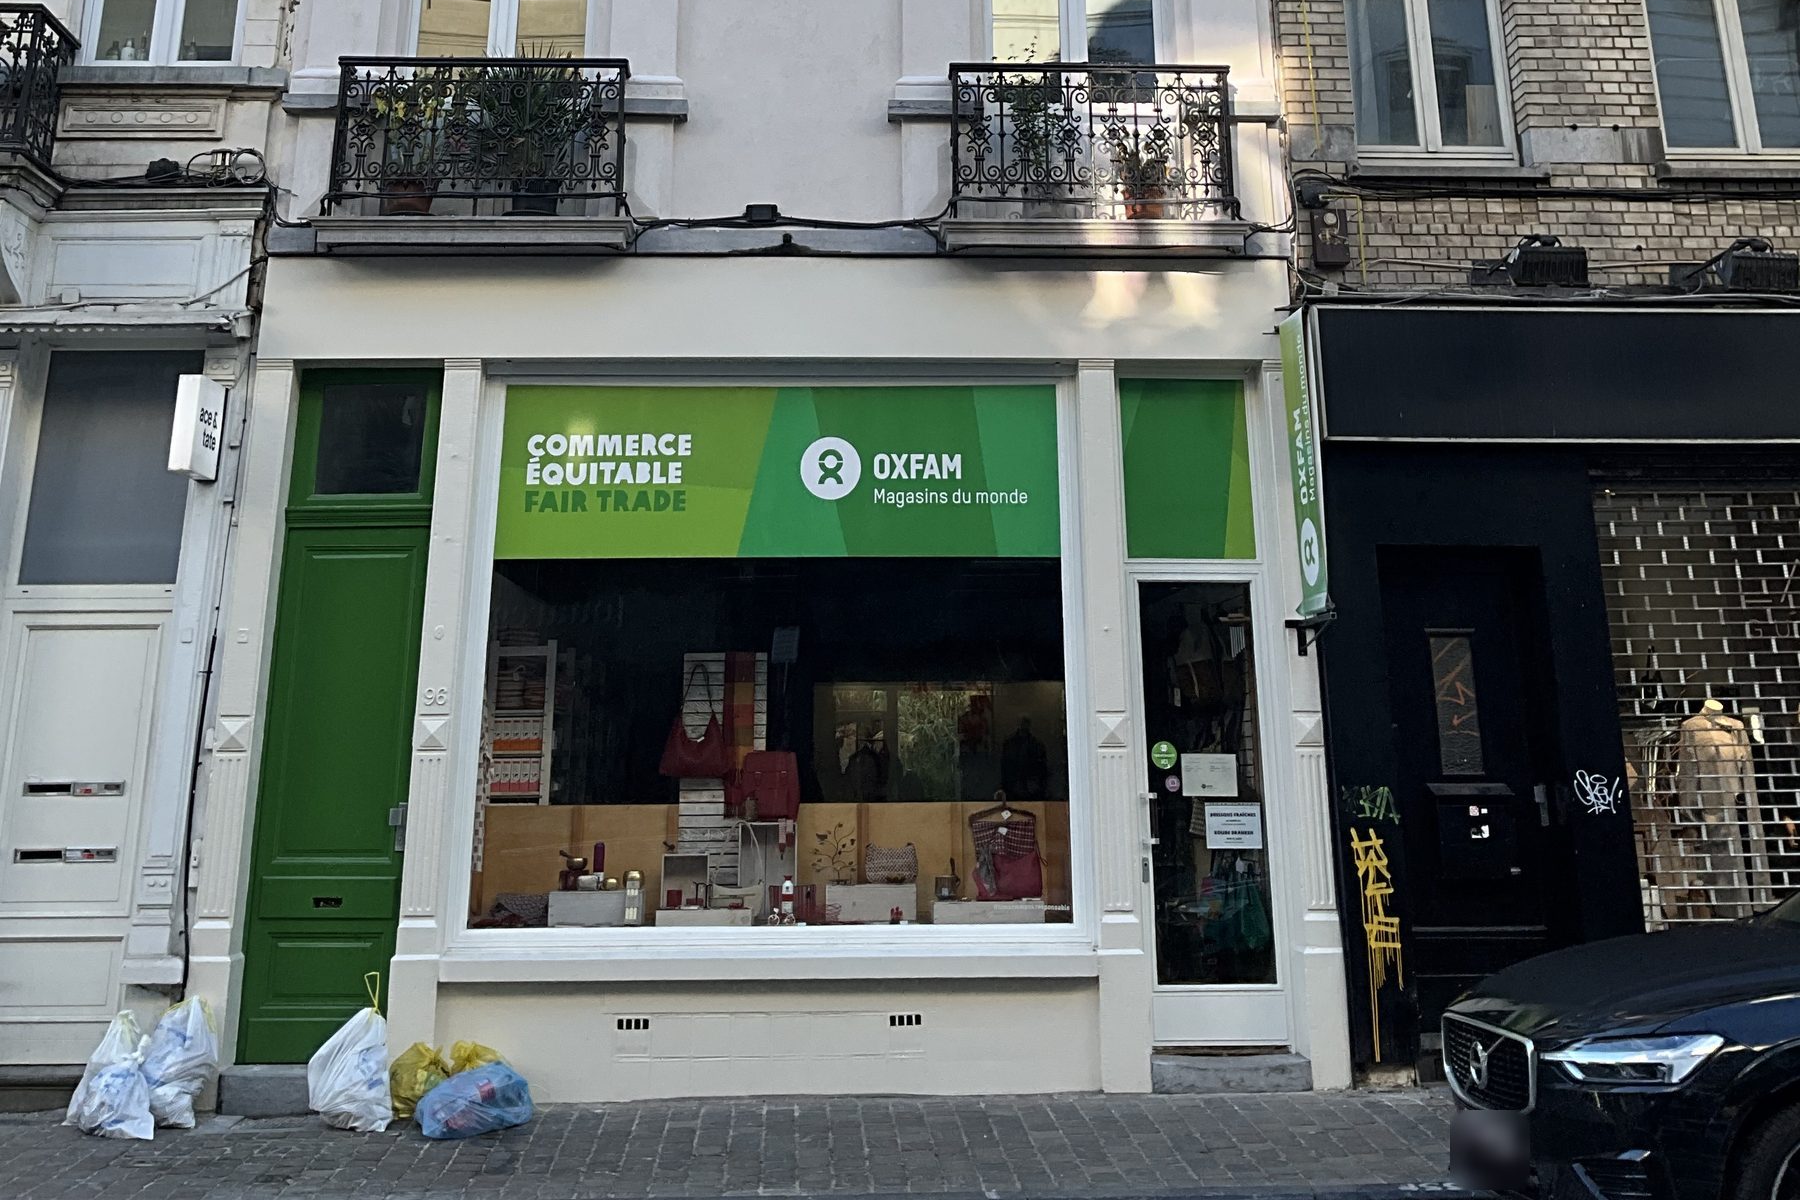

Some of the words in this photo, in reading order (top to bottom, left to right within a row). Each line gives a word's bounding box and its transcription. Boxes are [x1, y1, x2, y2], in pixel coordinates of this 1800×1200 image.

[1296, 334, 1306, 391] monde
[1300, 393, 1309, 415] du
[199, 408, 212, 426] ace
[213, 411, 218, 429] &
[202, 429, 216, 451] tate
[527, 433, 692, 457] COMMERCE
[873, 453, 962, 480] OXFAM
[1292, 408, 1309, 505] OXFAM
[1302, 420, 1316, 502] Magasins
[525, 457, 683, 485] ÉQUITABLE
[524, 489, 588, 513] FAIR
[596, 489, 687, 512] TRADE
[873, 487, 948, 509] Magasins
[952, 487, 972, 505] du
[975, 487, 1029, 505] monde
[423, 687, 447, 706] 96
